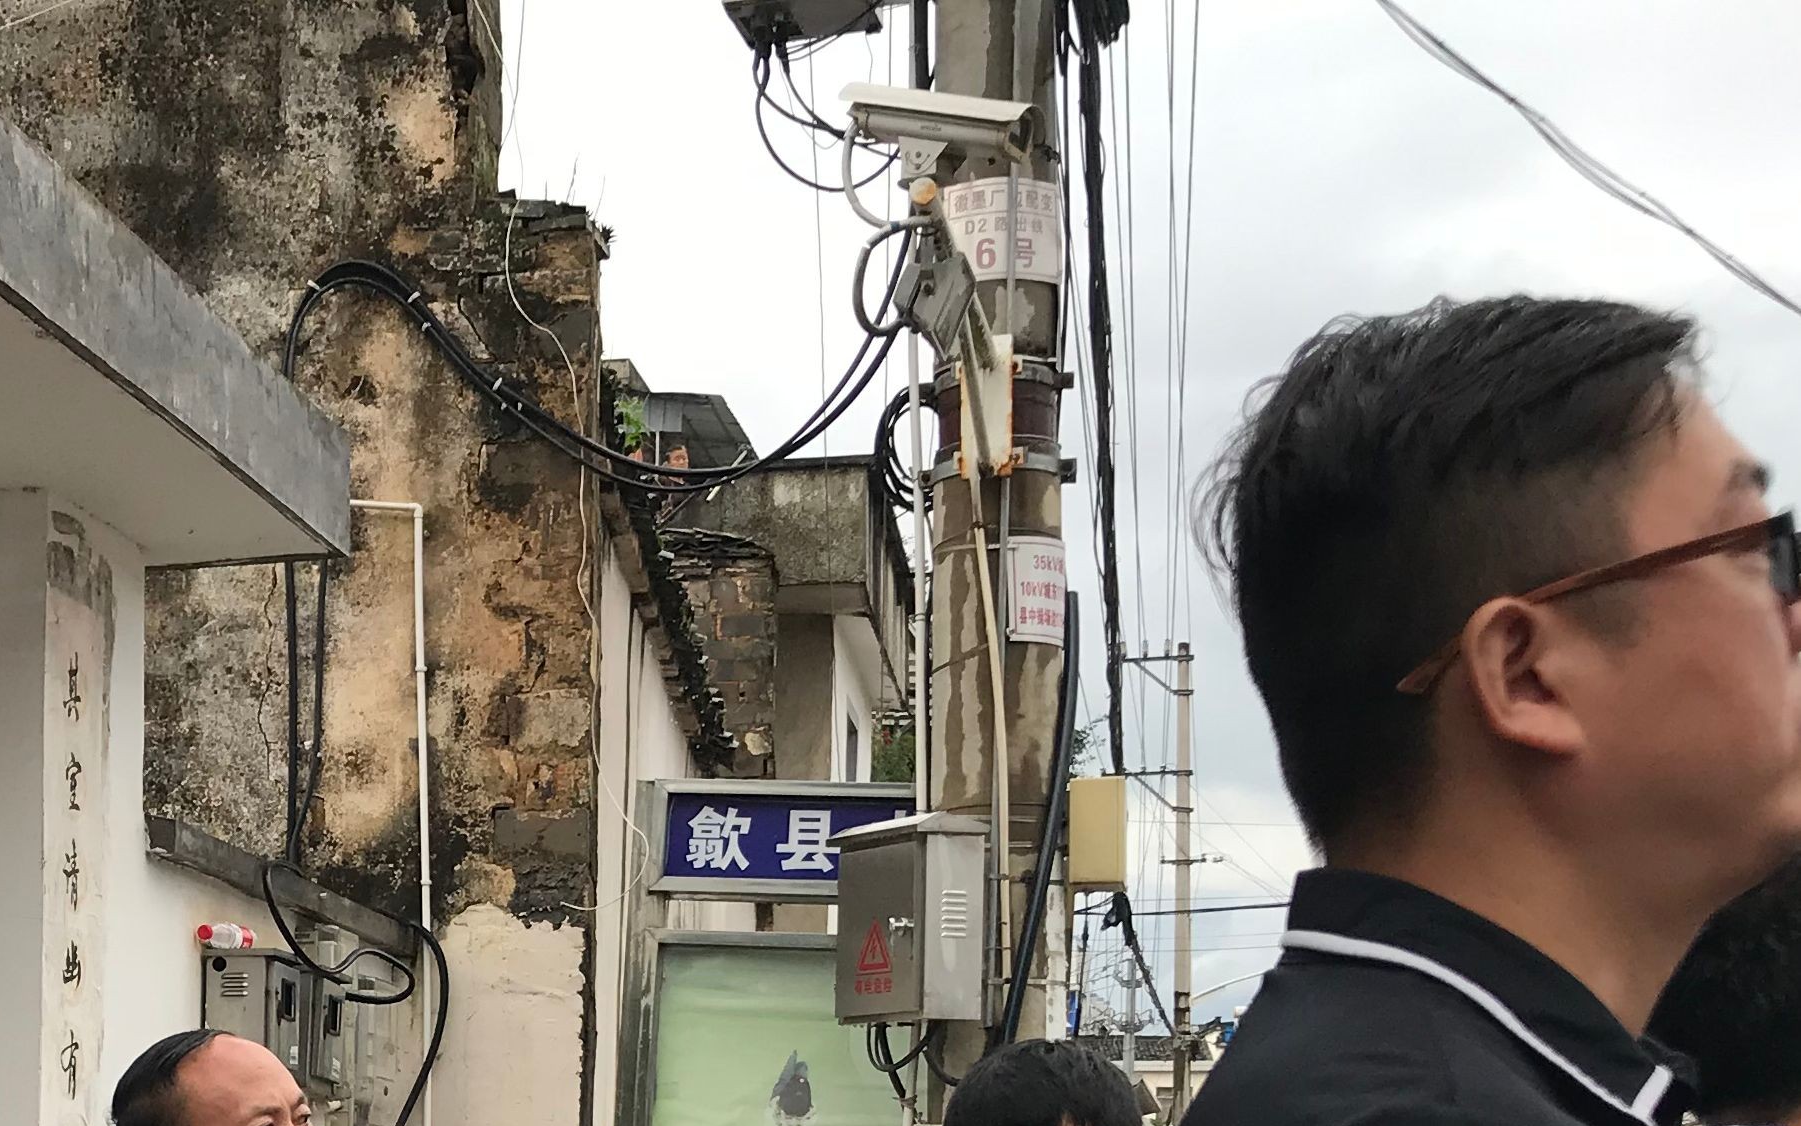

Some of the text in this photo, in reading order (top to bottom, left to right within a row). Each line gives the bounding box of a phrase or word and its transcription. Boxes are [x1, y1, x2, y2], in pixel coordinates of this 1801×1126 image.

[964, 217, 988, 235] D2
[975, 237, 1036, 270] 6号
[686, 806, 910, 873] 歙县
